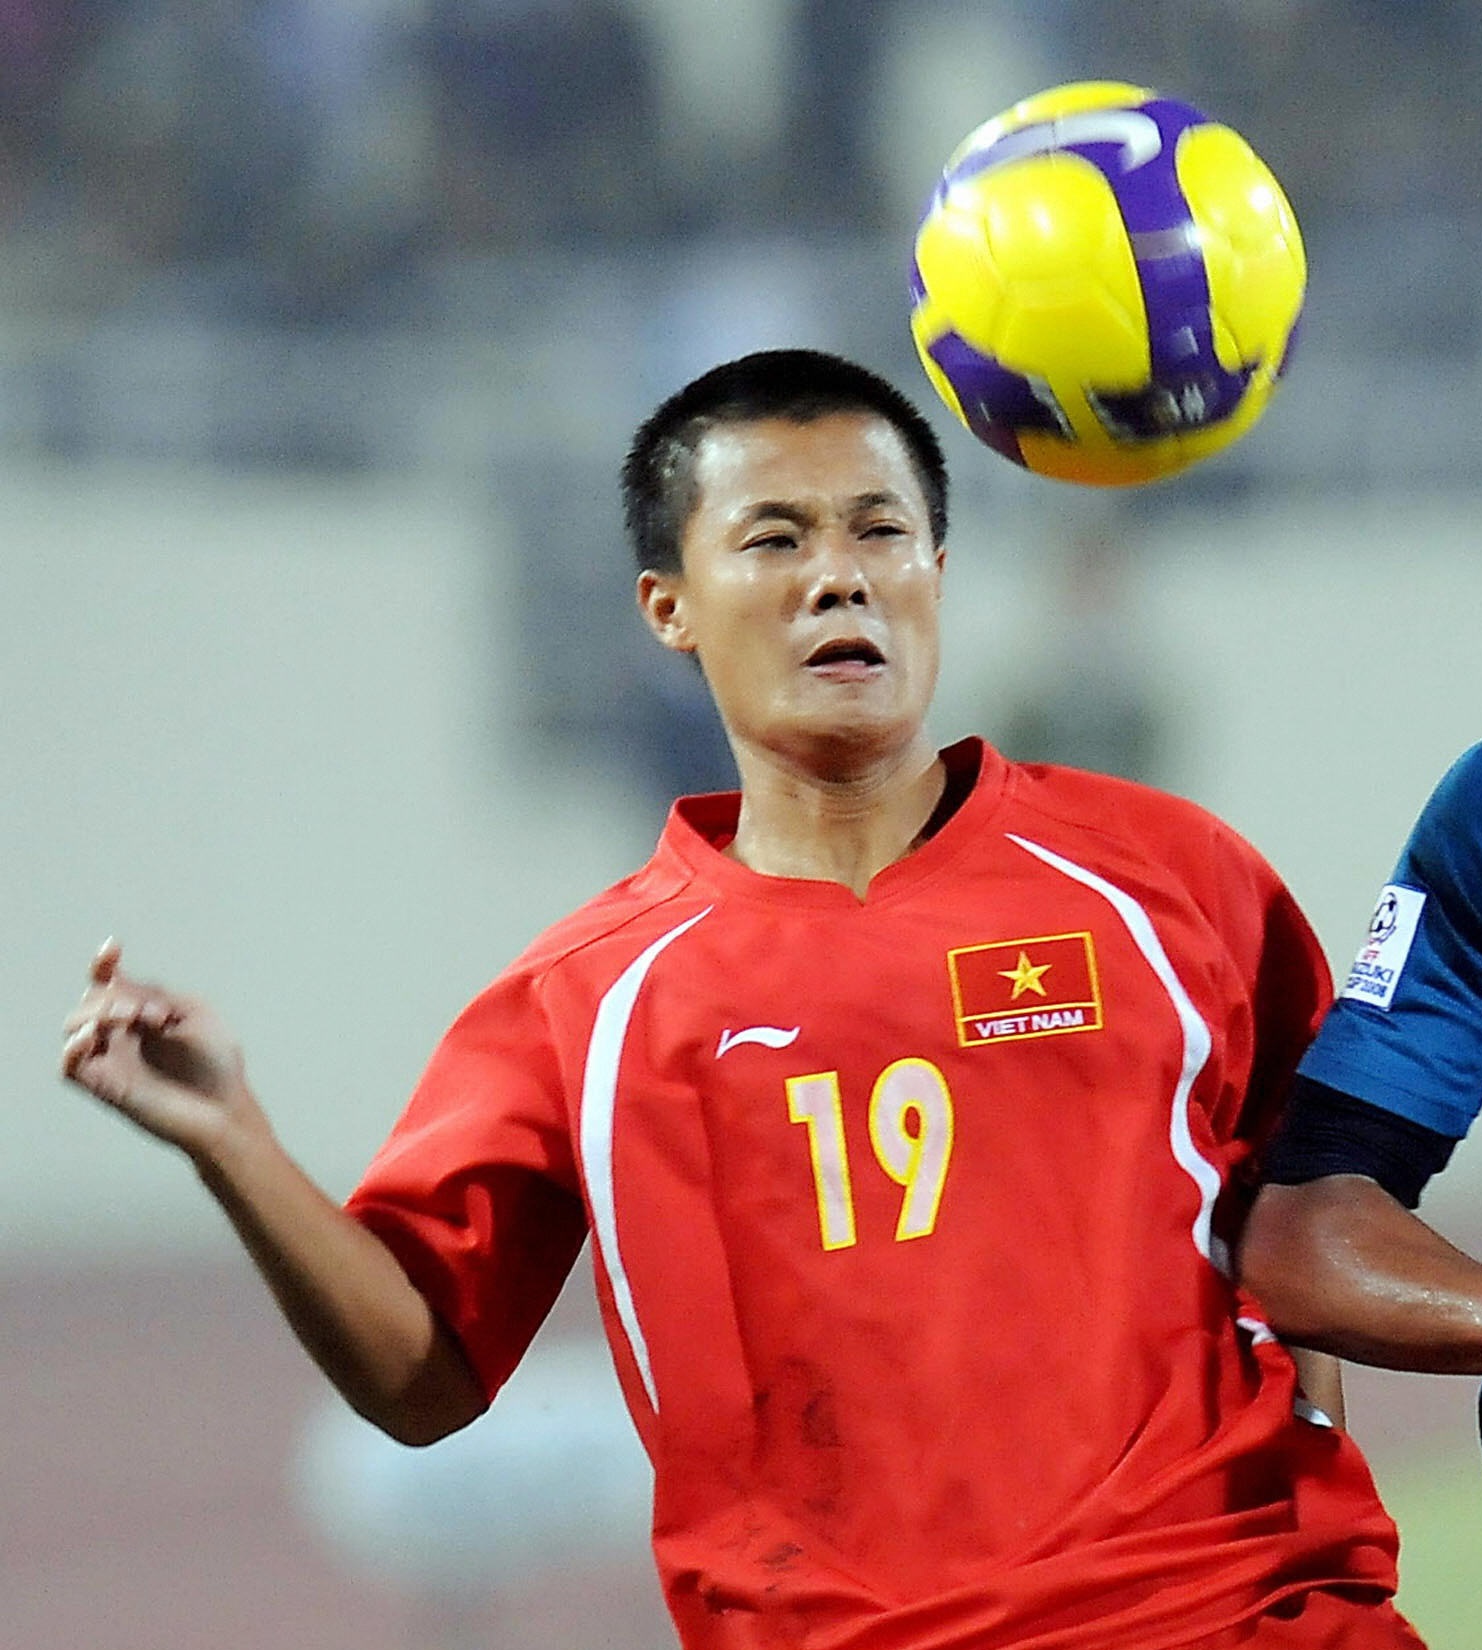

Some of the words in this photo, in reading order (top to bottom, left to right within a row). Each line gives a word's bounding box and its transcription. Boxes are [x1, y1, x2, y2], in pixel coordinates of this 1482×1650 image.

[975, 1016, 1029, 1038] VIET
[1031, 1009, 1085, 1031] NAM
[784, 1057, 955, 1251] 19
